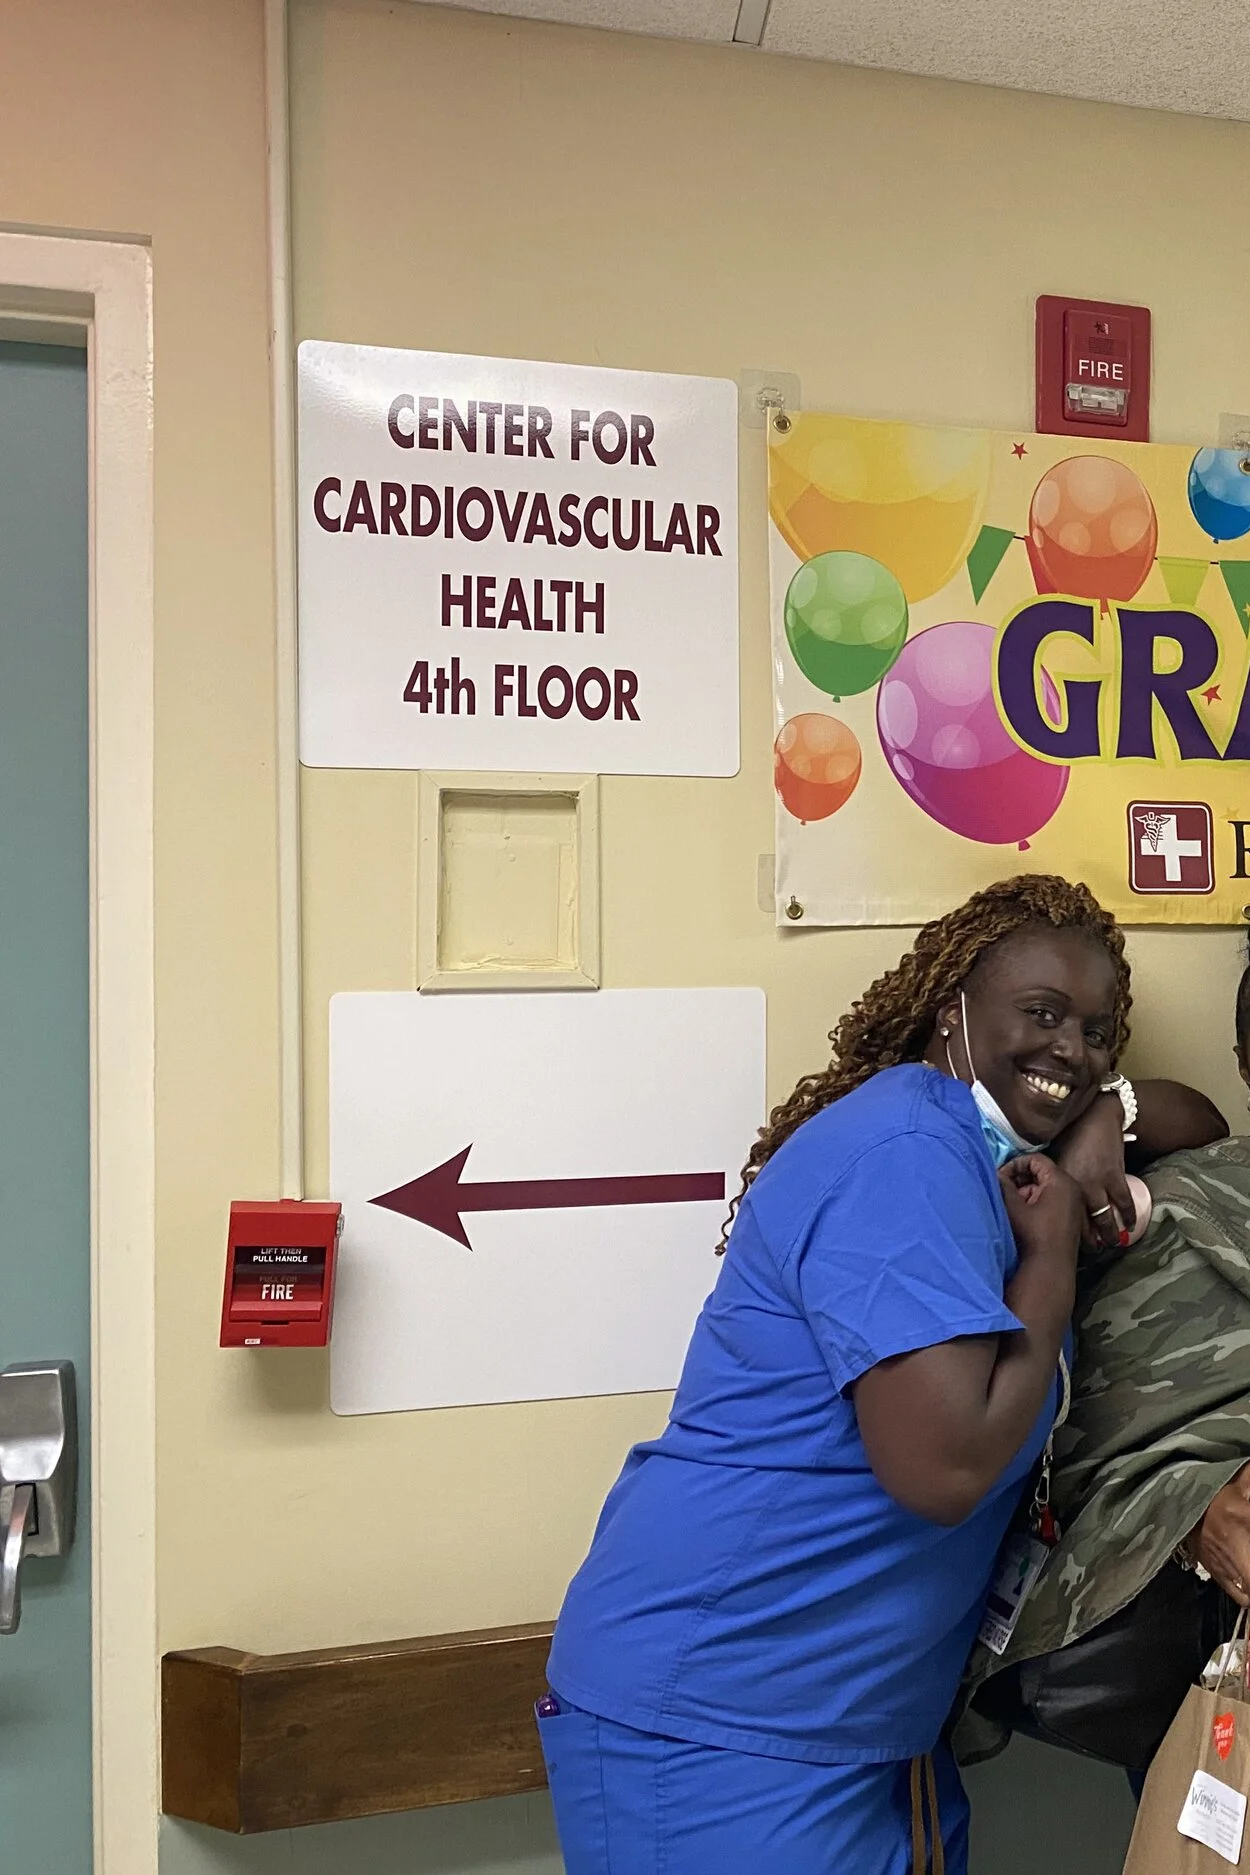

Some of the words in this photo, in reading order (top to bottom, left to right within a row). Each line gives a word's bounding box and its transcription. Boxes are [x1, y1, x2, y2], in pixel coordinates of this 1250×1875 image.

[1078, 359, 1124, 381] FIRE
[387, 394, 555, 459] CENTER
[570, 408, 657, 467] FOR
[313, 476, 723, 557] CARDIOVASCULAR
[440, 573, 605, 635] HEALTH
[402, 656, 477, 716] 4th
[494, 663, 642, 722] FLOOR
[261, 1284, 295, 1300] FIRE
